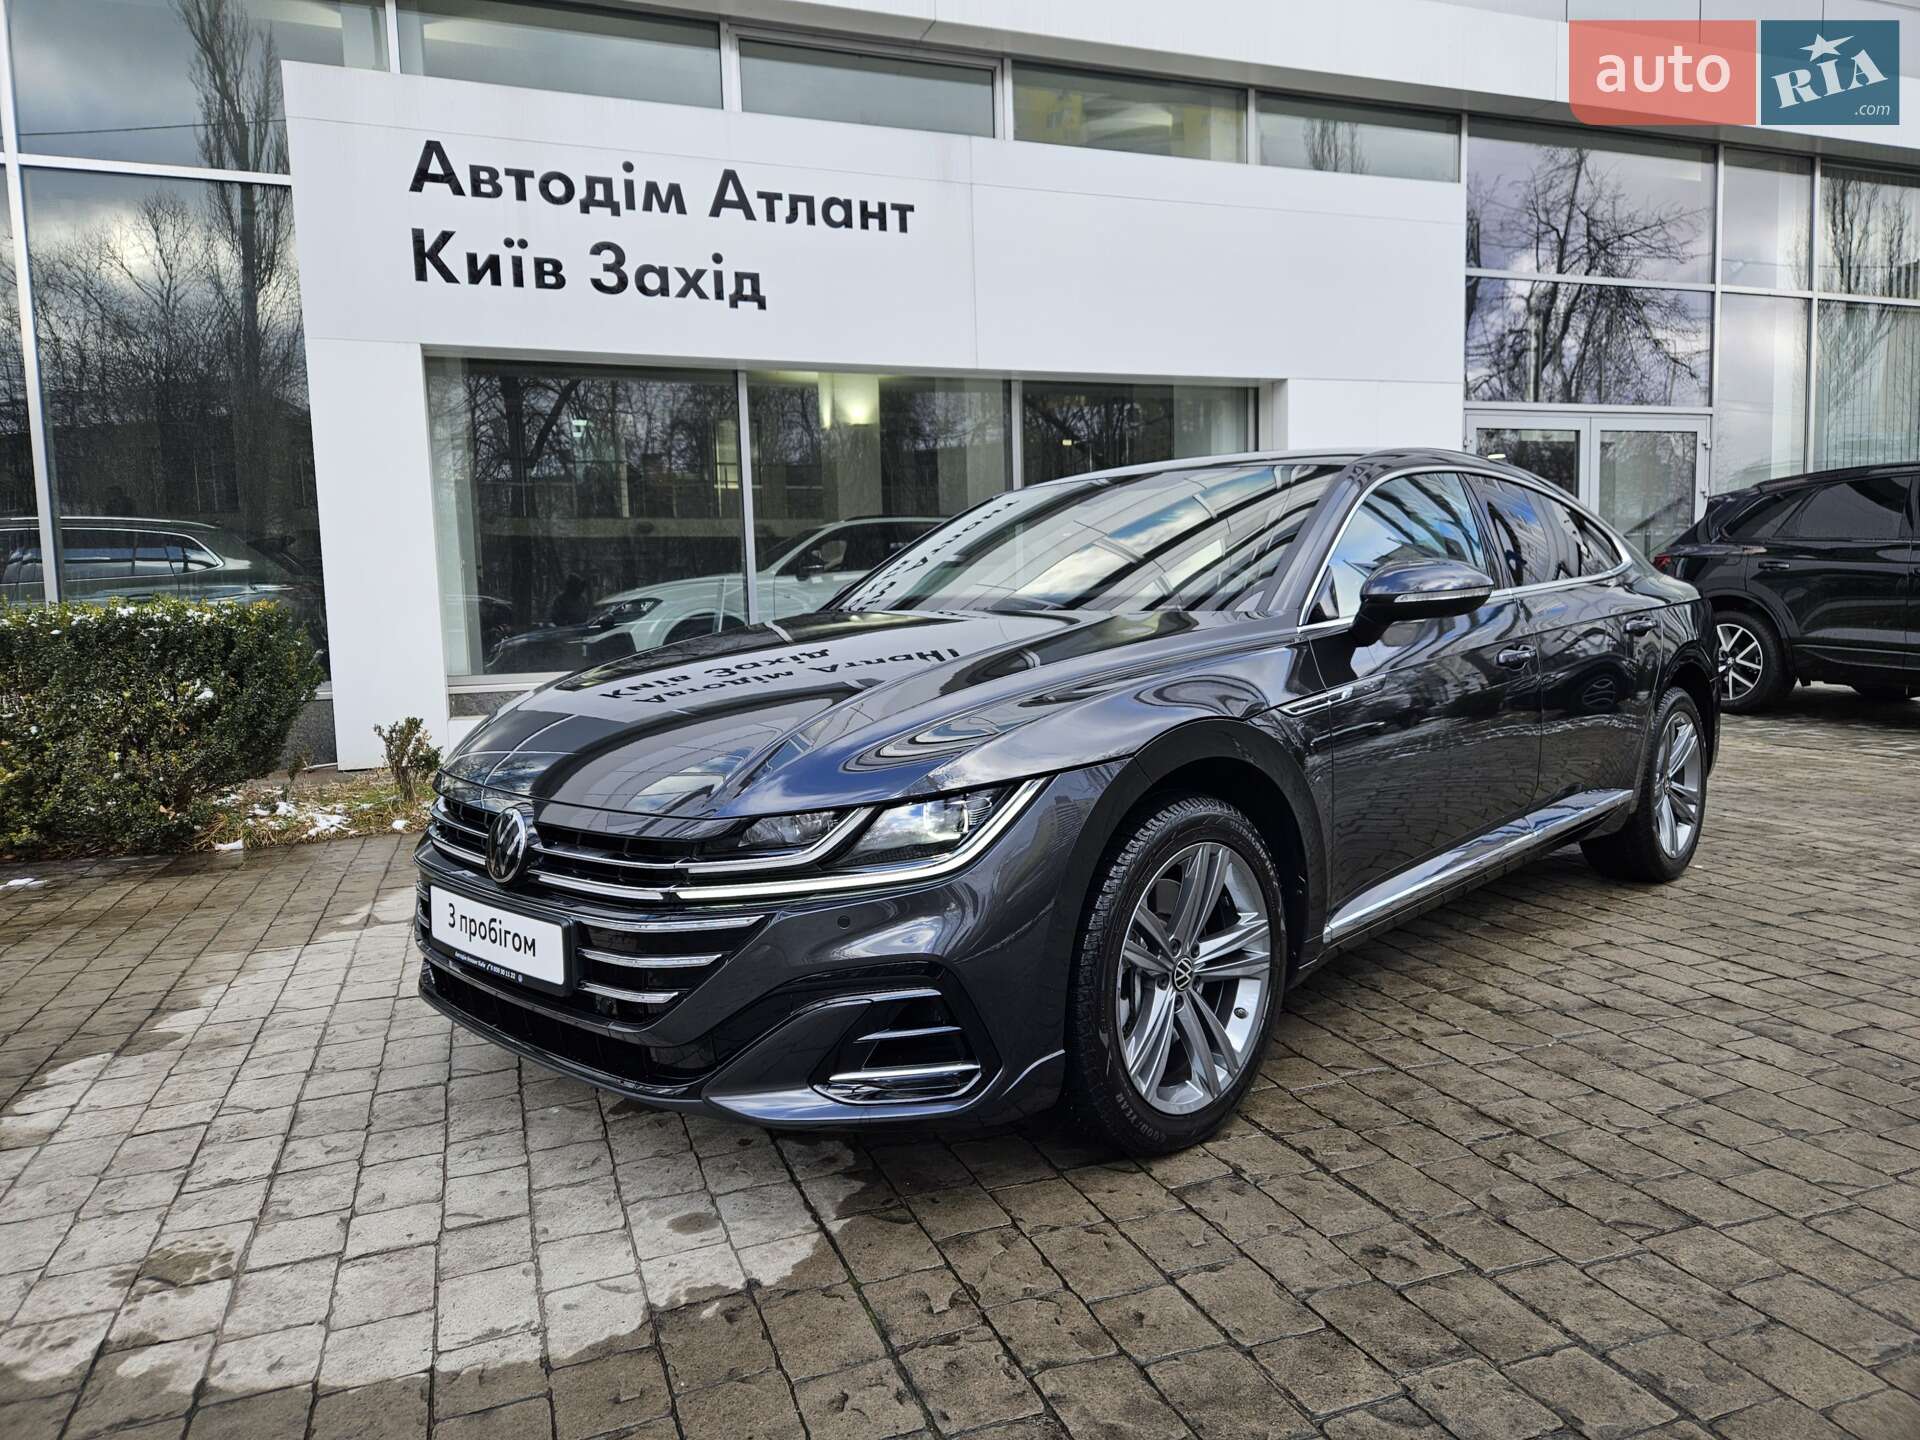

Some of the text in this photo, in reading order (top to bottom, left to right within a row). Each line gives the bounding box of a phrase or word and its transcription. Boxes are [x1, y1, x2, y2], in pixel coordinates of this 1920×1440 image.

[408, 139, 915, 234] Автодім Атлант
[411, 227, 767, 311] Київ Захід
[459, 914, 536, 957] пробігом
